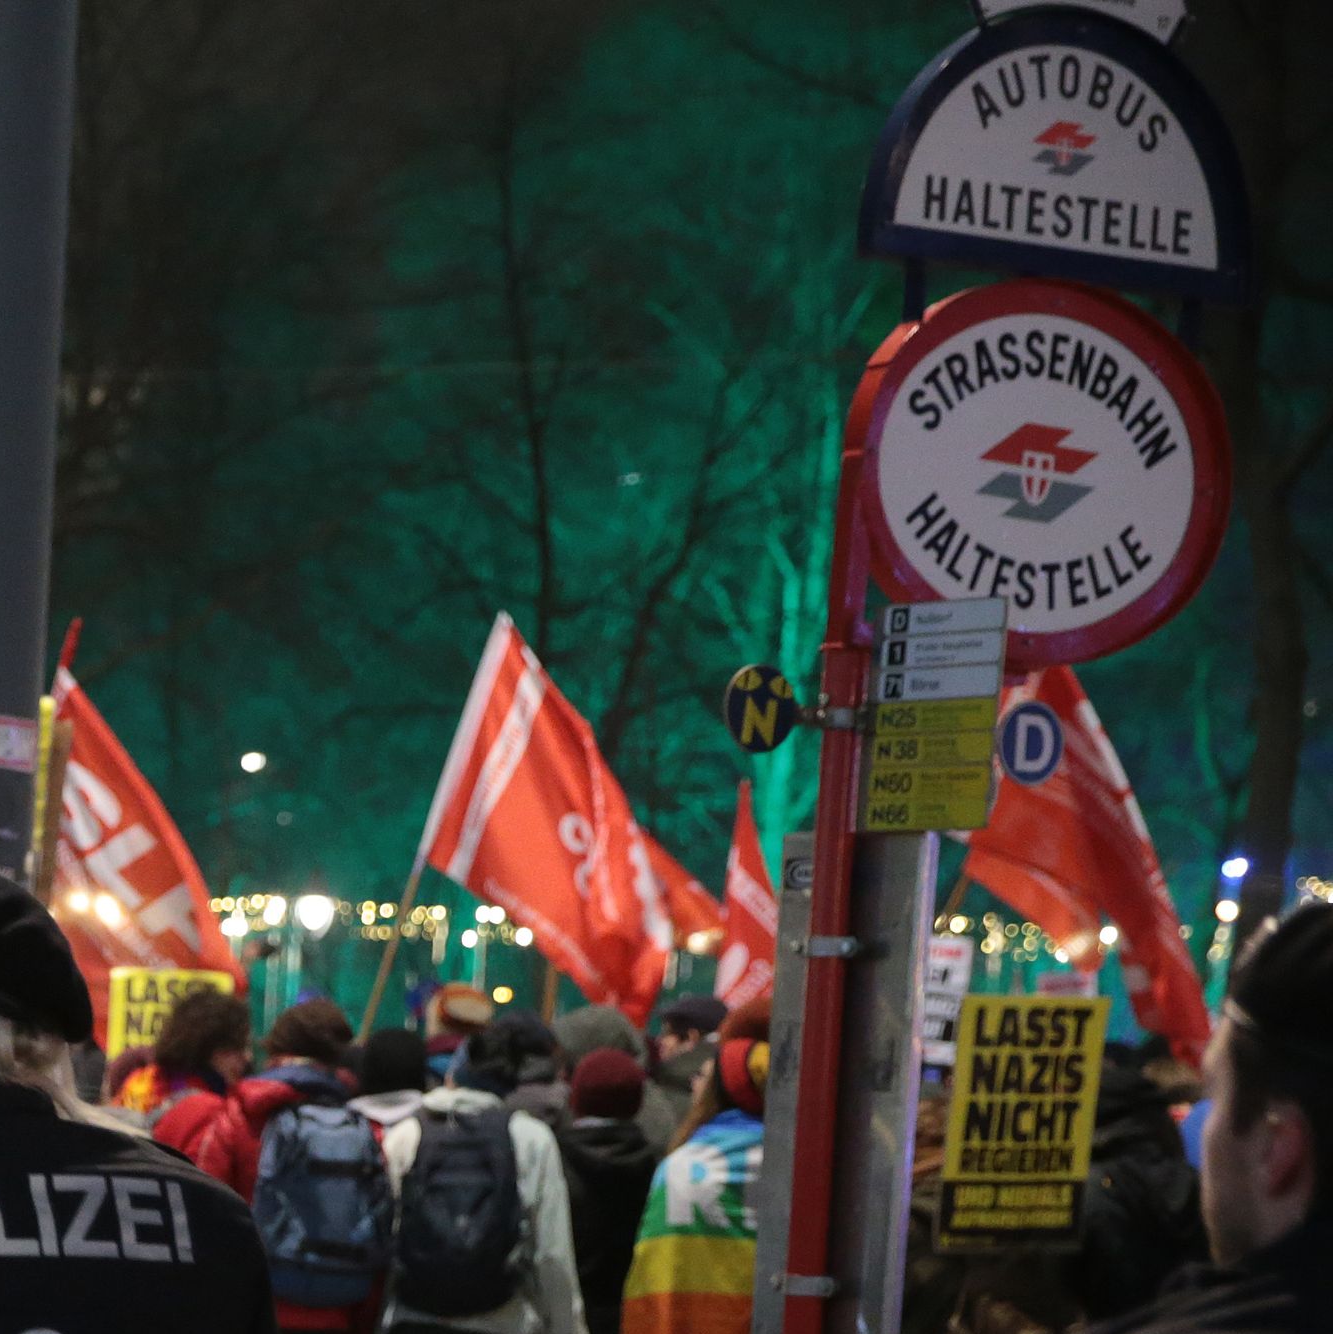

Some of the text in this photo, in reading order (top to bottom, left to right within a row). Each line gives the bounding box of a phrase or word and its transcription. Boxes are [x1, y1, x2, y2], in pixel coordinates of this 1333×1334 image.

[972, 54, 1169, 152] AUTOBUS
[923, 175, 1193, 256] HALTESTELLE
[908, 329, 1178, 470] STRASSENBAHN
[905, 493, 1153, 611] HALTESTELLE
[740, 695, 779, 747] N
[1013, 713, 1055, 773] D
[974, 1005, 1094, 1048] LASST
[970, 1053, 1086, 1095] NAZIS
[964, 1100, 1080, 1142] NICHT
